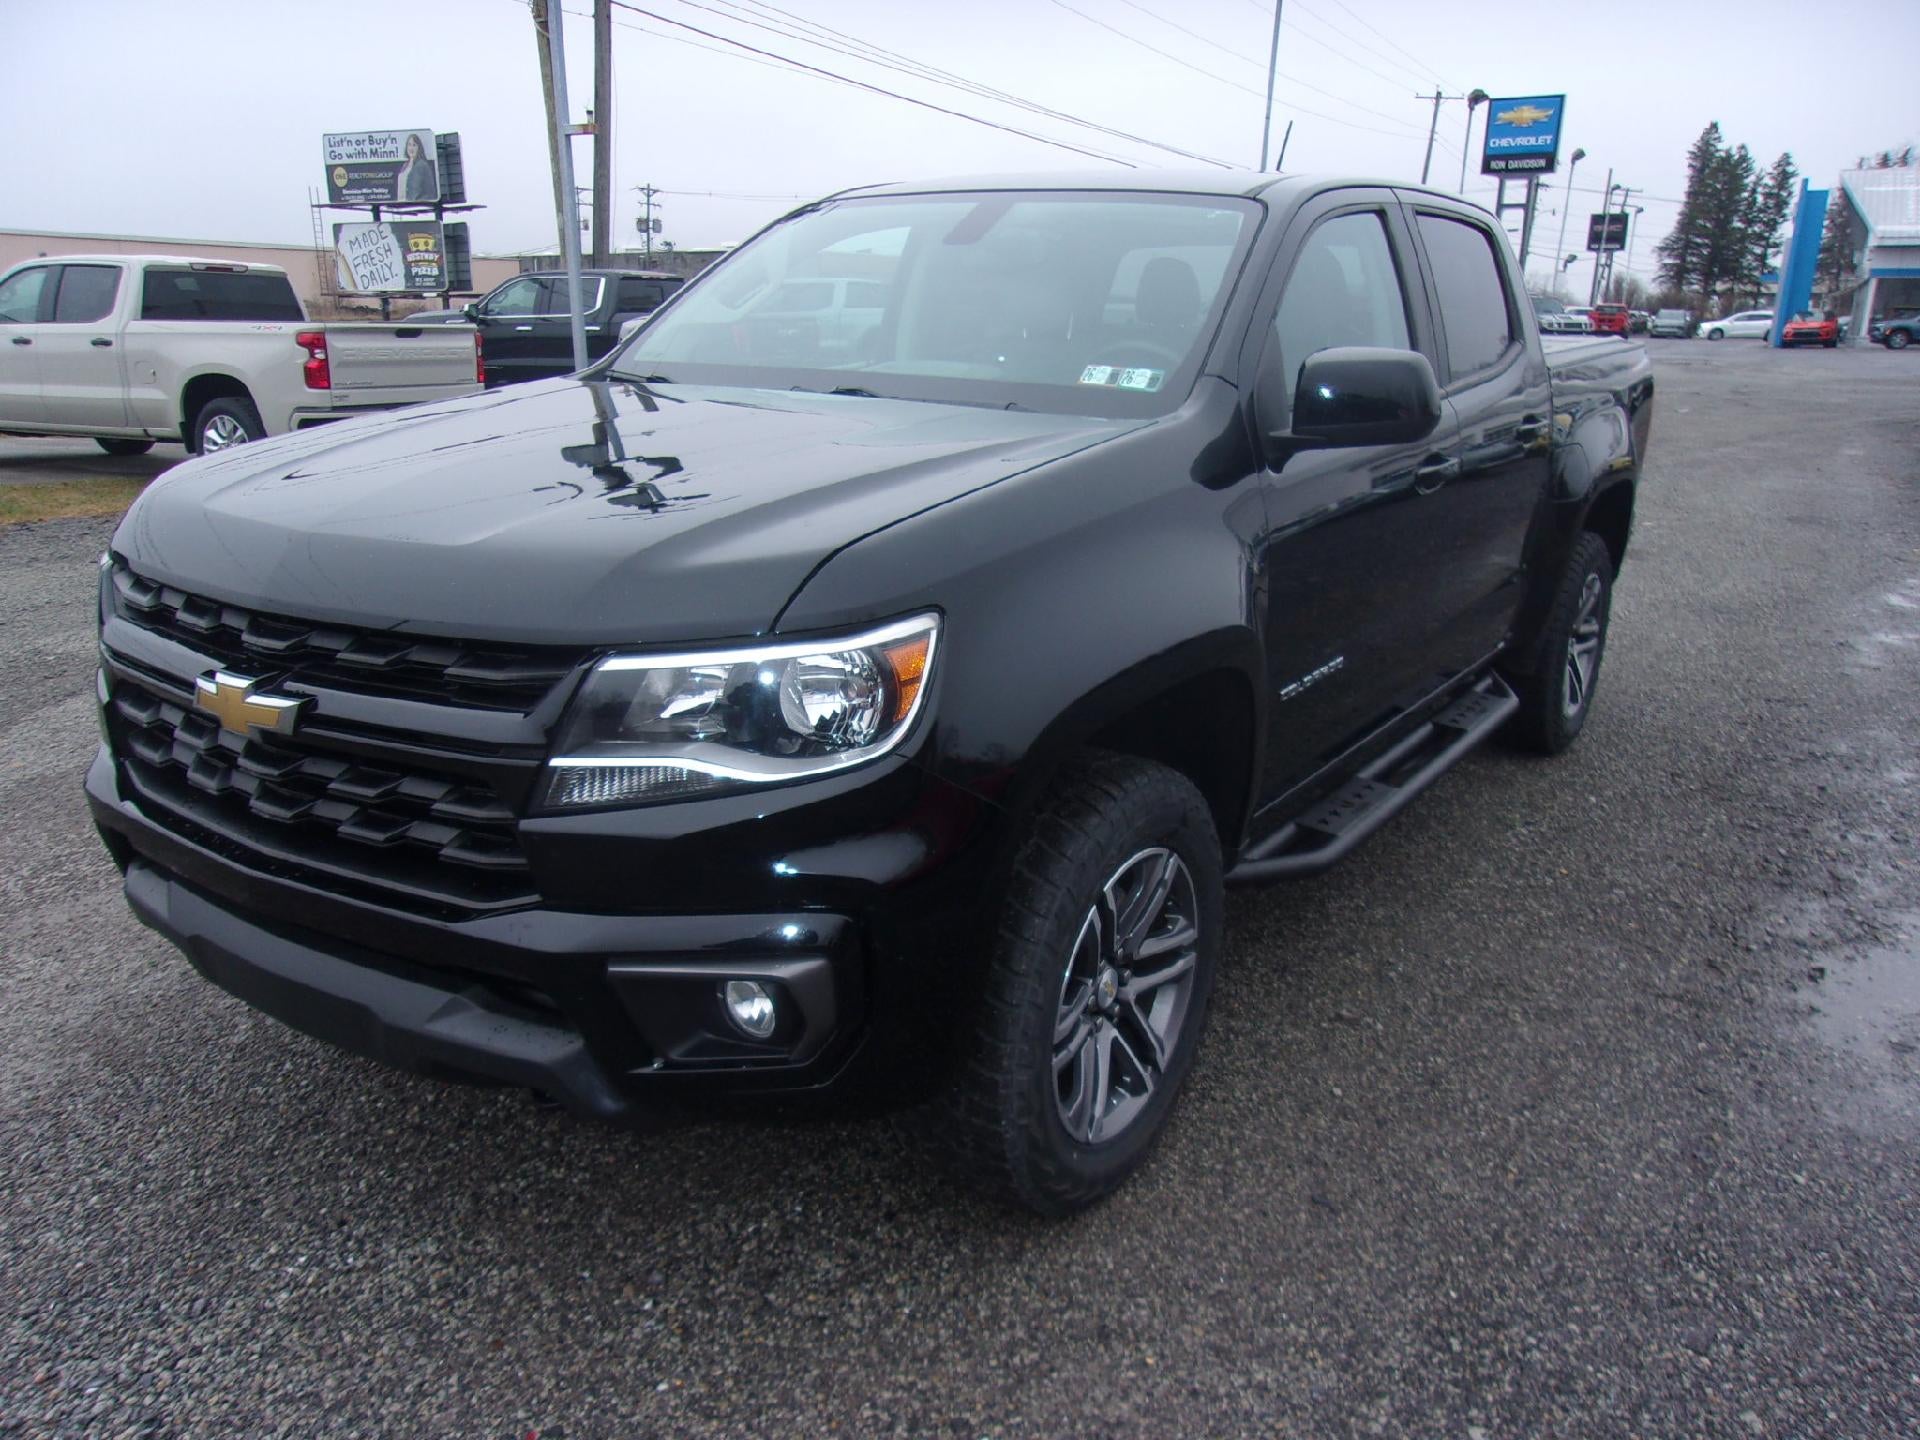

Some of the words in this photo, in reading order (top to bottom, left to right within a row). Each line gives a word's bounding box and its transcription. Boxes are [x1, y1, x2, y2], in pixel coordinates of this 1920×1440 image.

[328, 136, 353, 148] List'n
[354, 138, 366, 146] or
[367, 134, 397, 148] Buy'n
[1489, 135, 1553, 147] CHEVROLET
[329, 150, 343, 160] Go
[345, 147, 368, 159] with
[369, 146, 399, 159] Minn!
[1489, 160, 1506, 169] RON
[1507, 159, 1546, 169] DAVIDSON
[349, 223, 388, 254] MADE
[352, 242, 393, 276] FRESH
[360, 262, 398, 290] DAILY.
